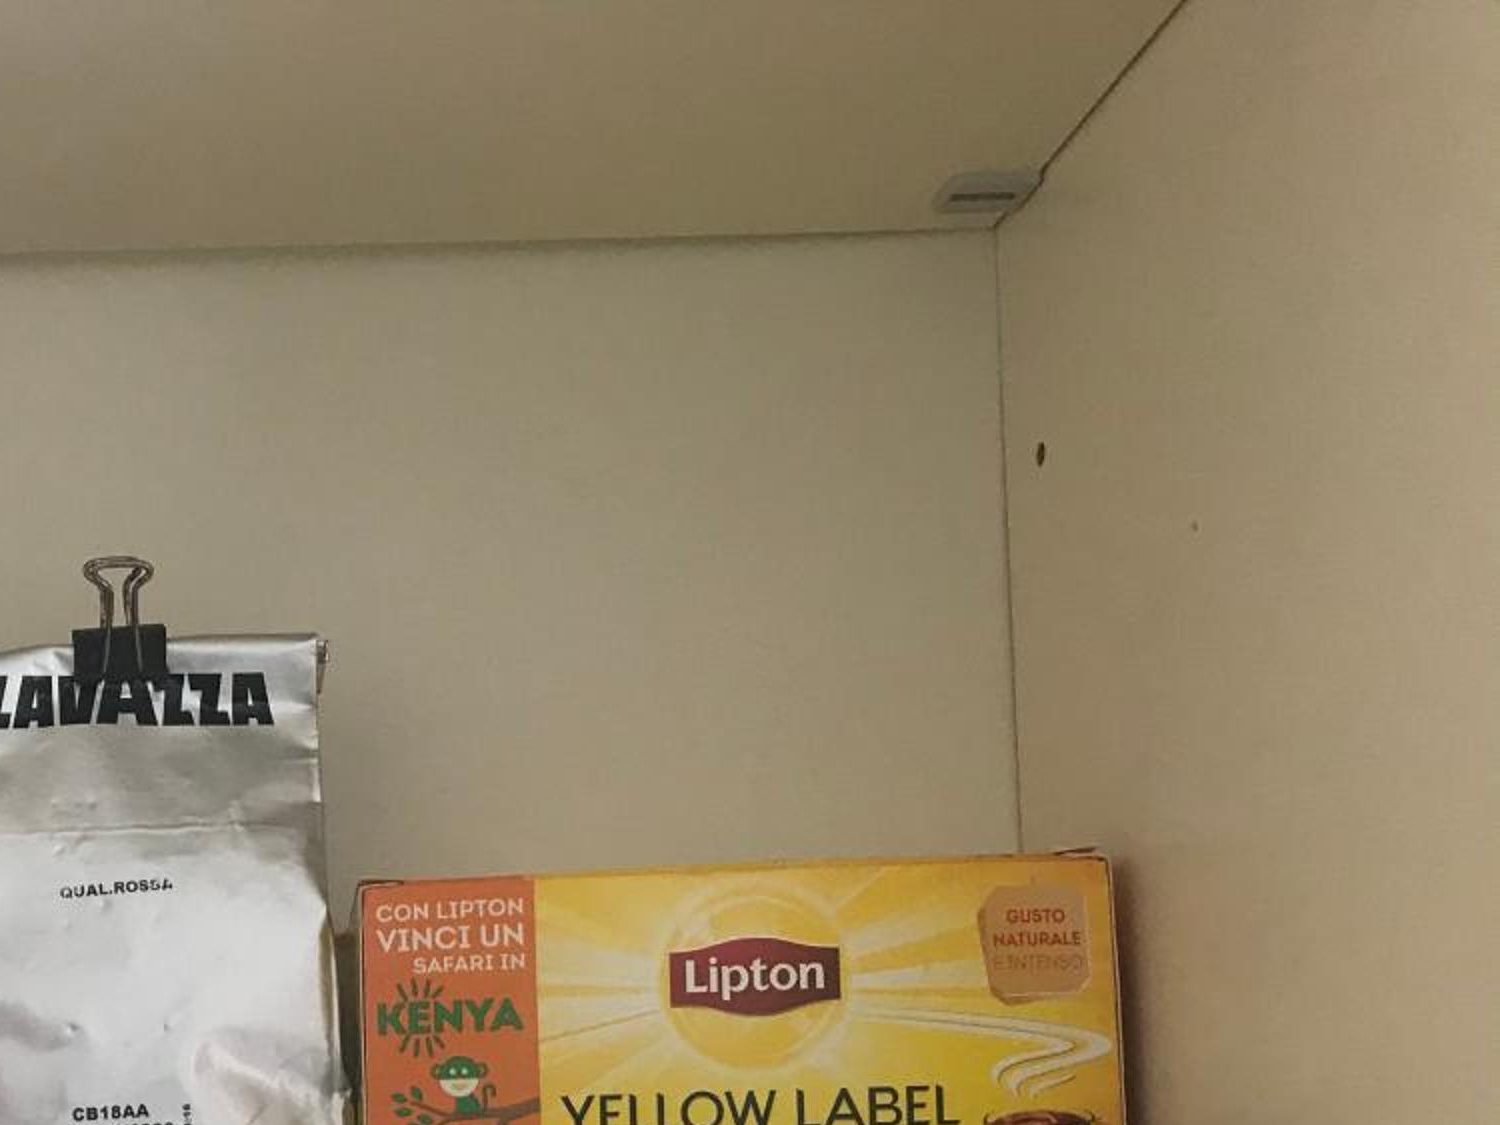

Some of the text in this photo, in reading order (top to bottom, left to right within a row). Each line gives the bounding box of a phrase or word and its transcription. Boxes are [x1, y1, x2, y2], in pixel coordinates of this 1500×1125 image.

[376, 898, 524, 923] CON LIPTON
[1006, 908, 1066, 925] GUSTO
[376, 923, 524, 952] VINCI UN
[993, 931, 1082, 948] NATURALE
[412, 953, 525, 975] SAFARI IN
[684, 956, 826, 1001] Lipton
[376, 997, 524, 1036] KENYA
[72, 1104, 149, 1121] CB18AA
